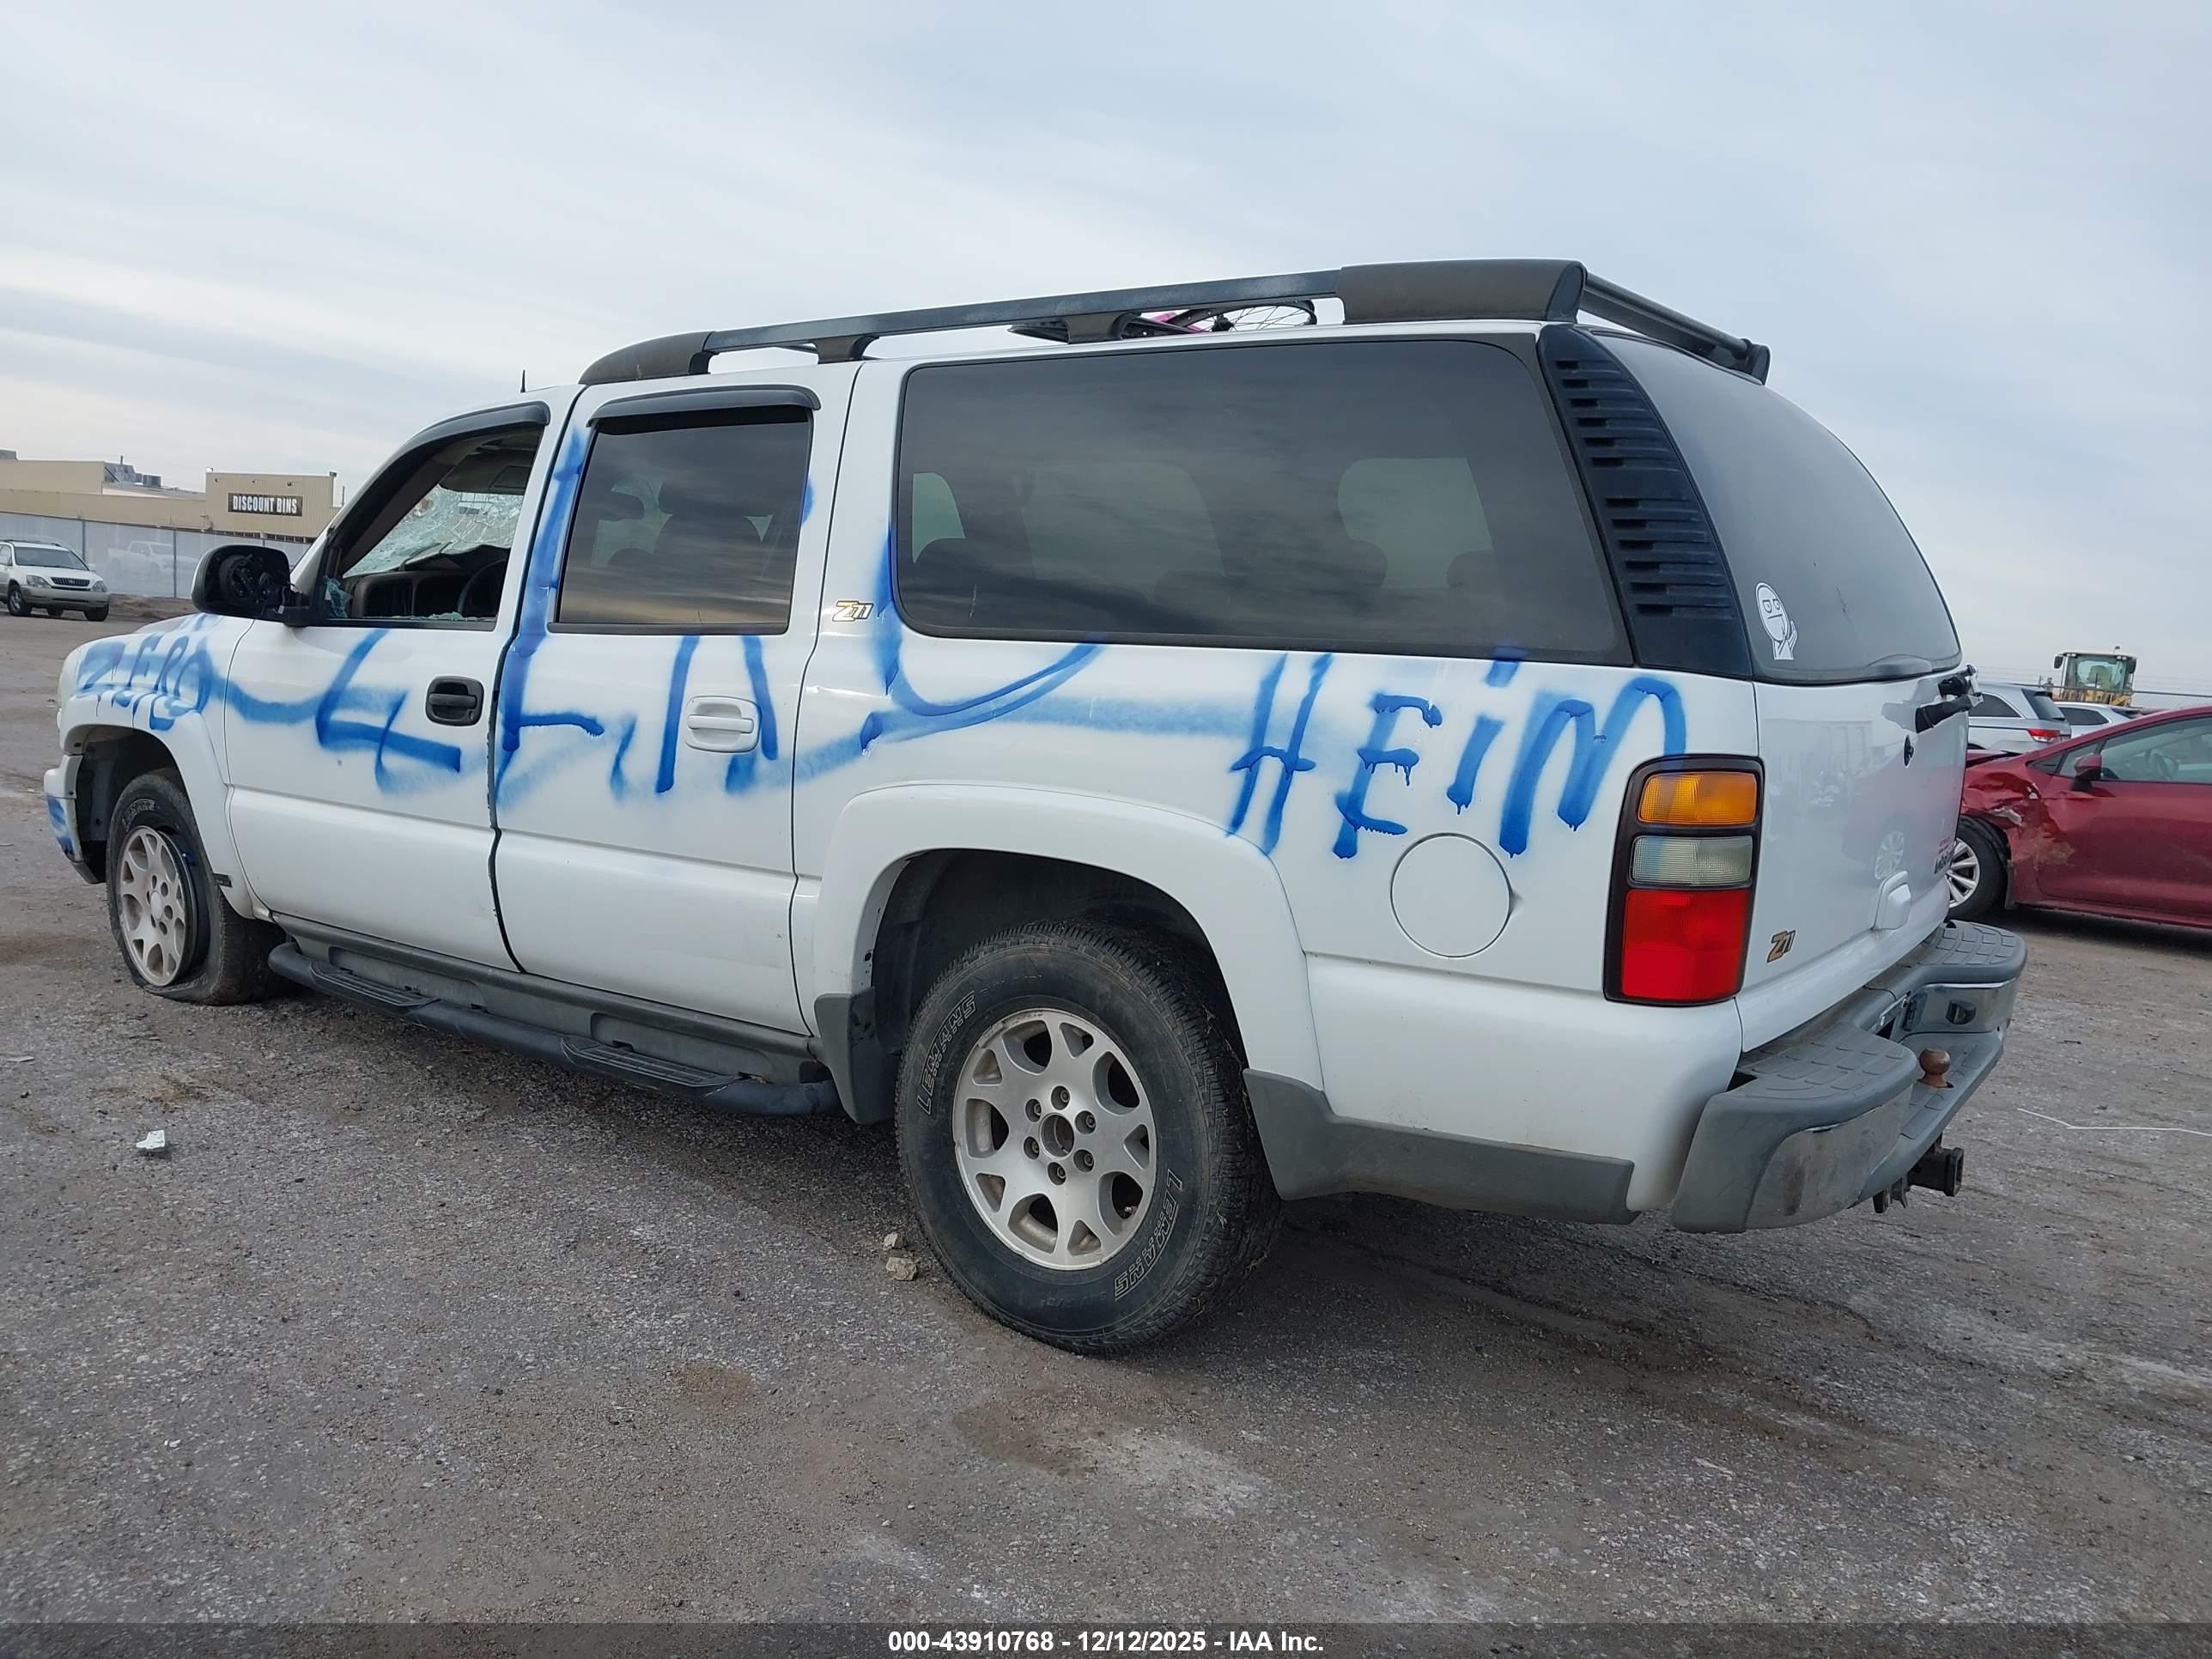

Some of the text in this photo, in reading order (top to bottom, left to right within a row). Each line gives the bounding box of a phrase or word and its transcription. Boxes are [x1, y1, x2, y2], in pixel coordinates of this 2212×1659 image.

[233, 495, 297, 514] DISCOUNT BINS
[832, 601, 873, 622] Z71
[1767, 930, 1796, 963] Z71
[916, 989, 976, 1115] LEMANS
[1115, 1169, 1182, 1301] LEMANS
